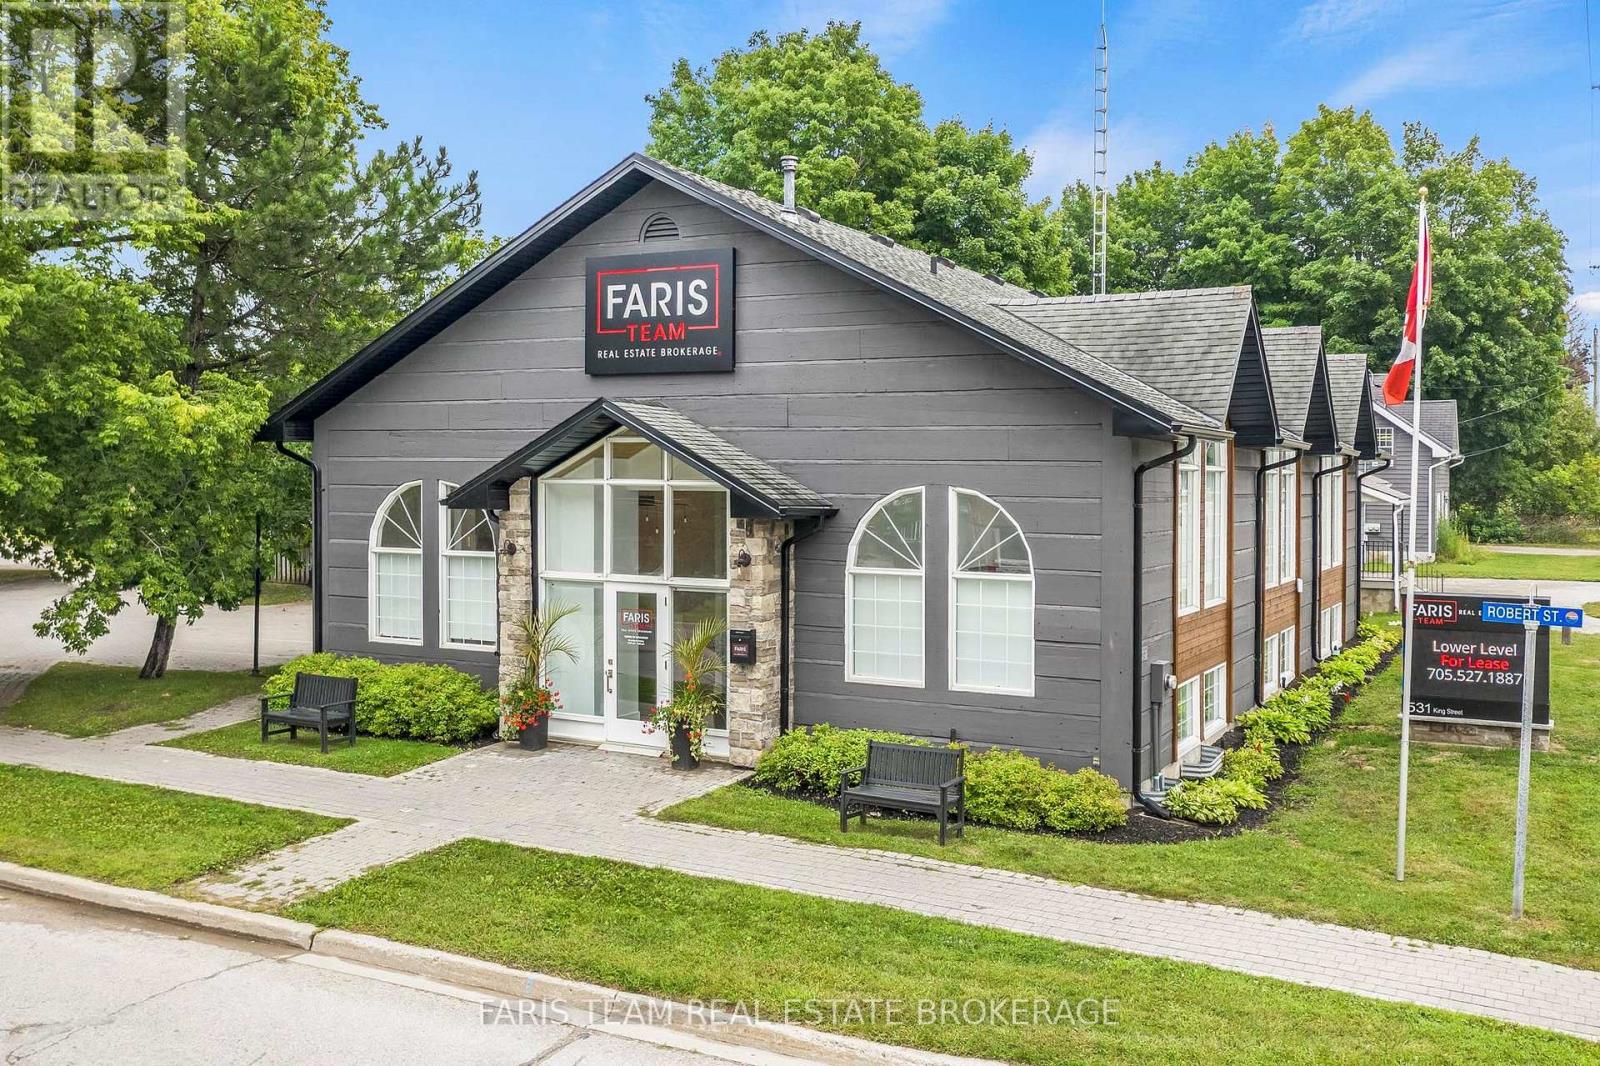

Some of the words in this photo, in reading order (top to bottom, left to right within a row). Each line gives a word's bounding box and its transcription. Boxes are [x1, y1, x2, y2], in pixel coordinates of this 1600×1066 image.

[606, 279, 708, 319] FARIS
[627, 321, 686, 342] TEAM
[597, 350, 620, 359] REAL
[624, 348, 656, 358] ESTATE
[660, 346, 718, 357] BROKERAGE
[623, 612, 650, 623] FARIS
[1417, 617, 1444, 625] TEAM
[1487, 606, 1538, 620] ROBERT
[1543, 610, 1562, 623] ST.
[1432, 640, 1476, 654] Lower
[1480, 642, 1517, 656] Level
[1440, 654, 1464, 667] For
[1468, 656, 1510, 671] Lease
[1426, 667, 1523, 685] 705.527.1887
[1433, 707, 1446, 716] King
